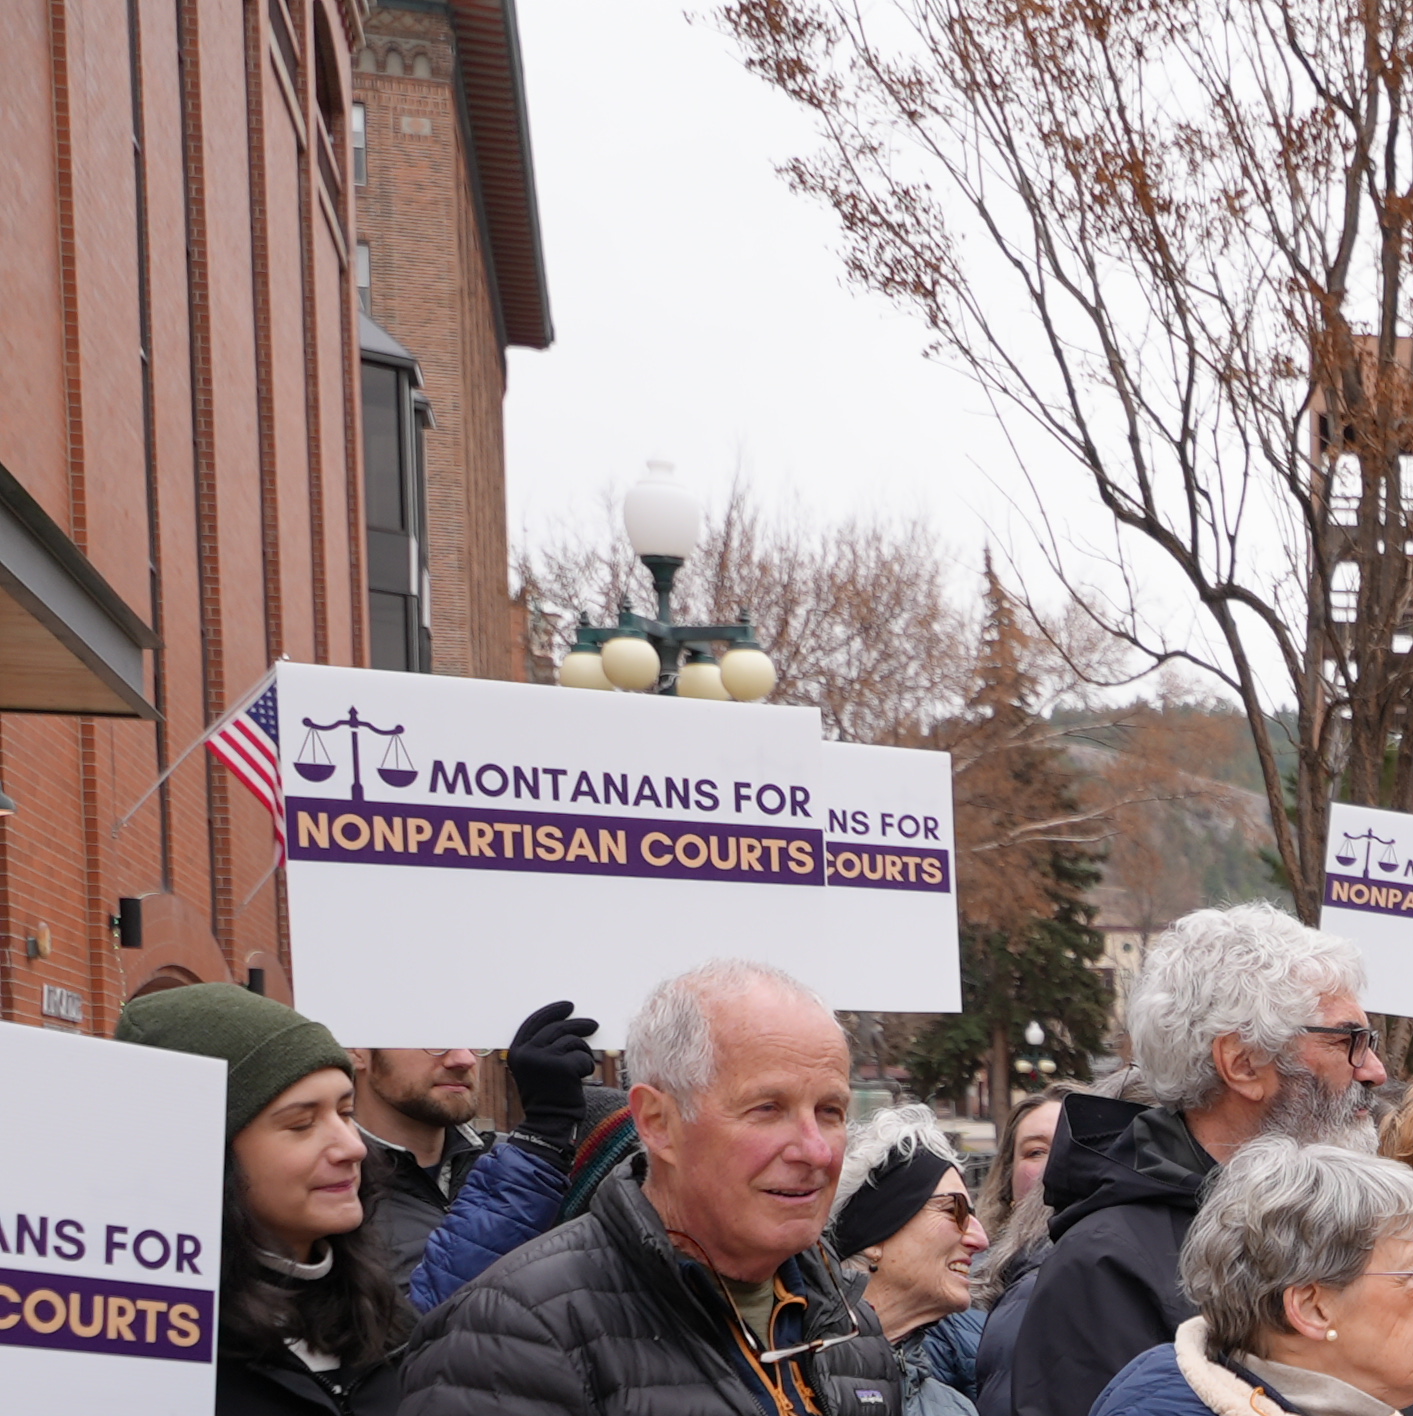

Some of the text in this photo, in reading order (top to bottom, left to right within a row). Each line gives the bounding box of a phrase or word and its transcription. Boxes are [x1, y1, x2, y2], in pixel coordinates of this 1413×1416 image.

[429, 760, 812, 818] MONTANANS FOR
[297, 811, 815, 876] NONPARTISAN COURTS
[880, 812, 941, 841] FOR
[105, 1224, 203, 1275] FOR
